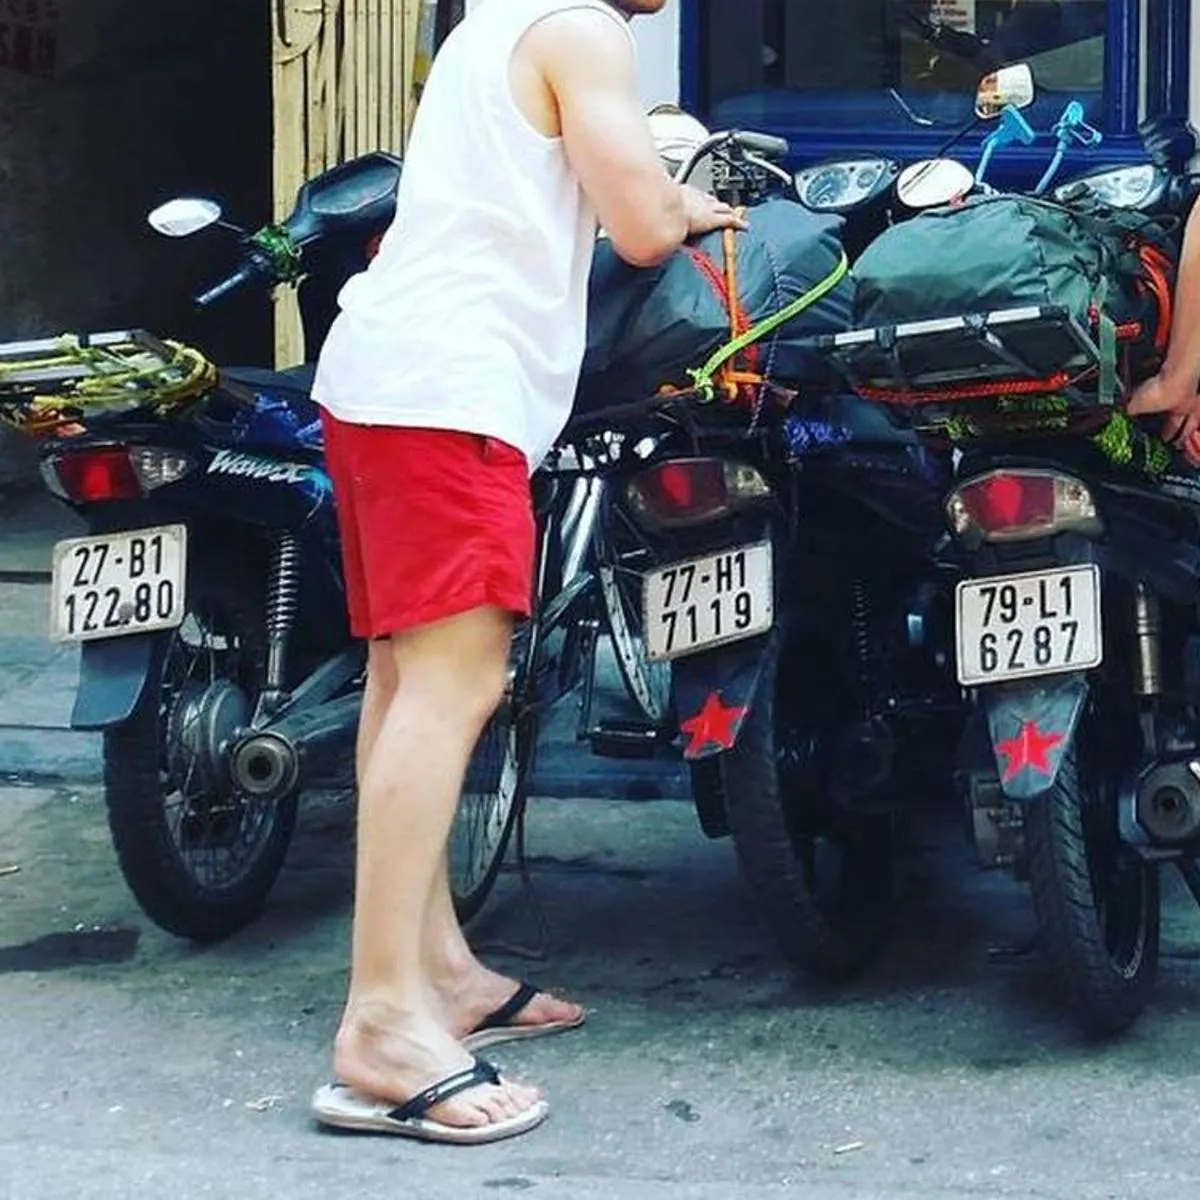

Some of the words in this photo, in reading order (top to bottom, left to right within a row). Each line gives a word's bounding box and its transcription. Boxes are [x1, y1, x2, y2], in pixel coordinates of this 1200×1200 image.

[73, 535, 163, 587] 27-B1
[661, 552, 746, 607] 77-H1
[661, 592, 751, 651] 7119
[979, 576, 1072, 627] 79-L1
[979, 620, 1078, 673] 6287
